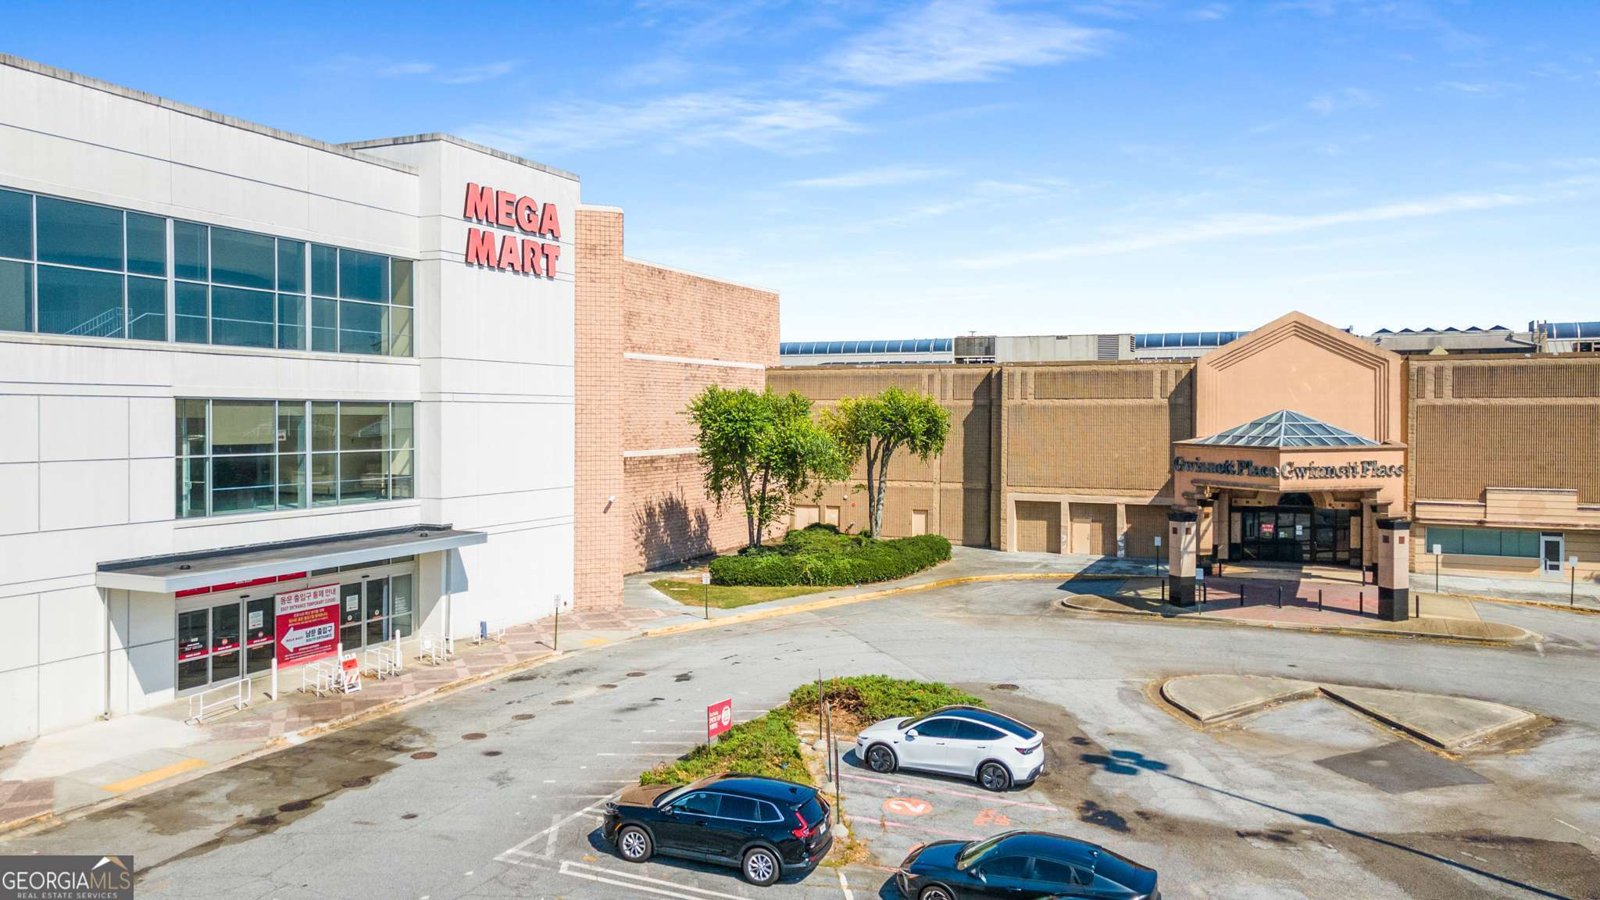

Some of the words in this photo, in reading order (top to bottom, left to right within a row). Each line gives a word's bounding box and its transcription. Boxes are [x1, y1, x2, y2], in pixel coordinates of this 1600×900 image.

[463, 182, 562, 242] MEGA
[465, 227, 561, 280] MART
[1174, 456, 1236, 475] Gwinnett
[1237, 460, 1280, 478] Place
[1281, 460, 1359, 480] Gwinnett
[1360, 460, 1404, 478] Place
